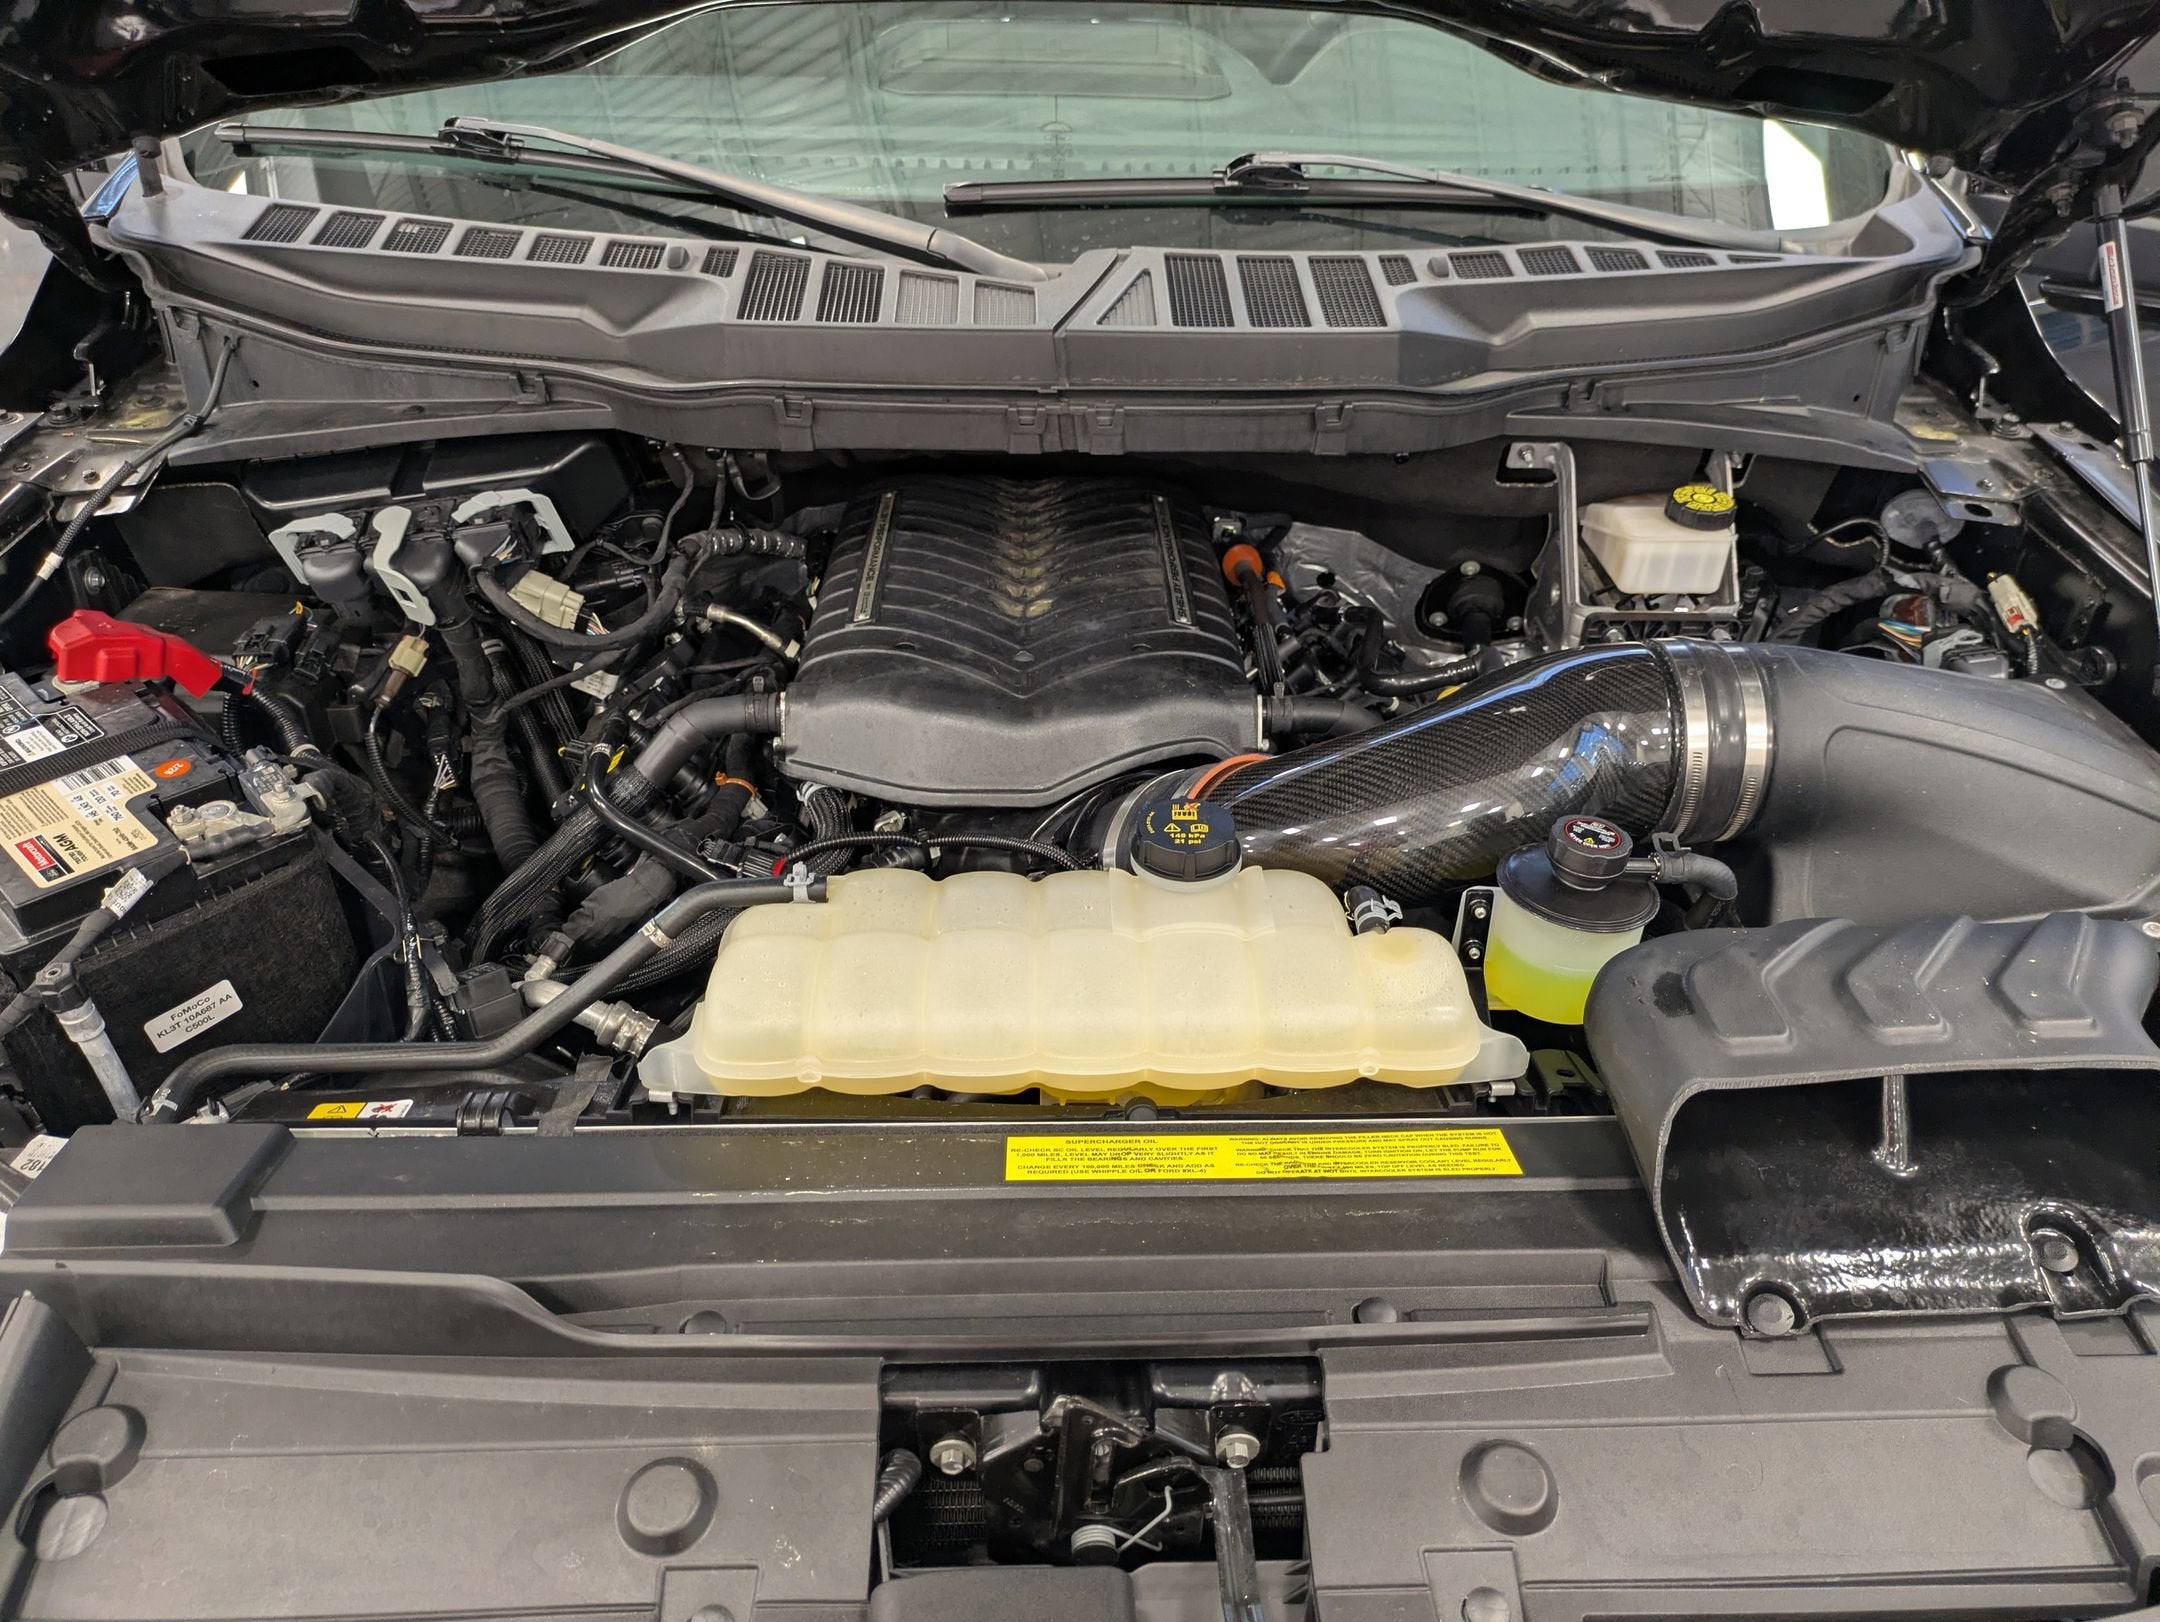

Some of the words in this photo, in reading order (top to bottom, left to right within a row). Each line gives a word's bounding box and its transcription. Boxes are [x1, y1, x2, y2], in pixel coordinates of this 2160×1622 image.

[866, 524, 886, 582] PERFORMANCE
[1162, 523, 1179, 581] PERFORMANCE
[1174, 582, 1187, 618] SHELBY
[21, 841, 50, 867] Motorcraft
[53, 832, 78, 852] AGM
[156, 1023, 182, 1039] KL3T
[184, 1002, 217, 1024] 10A687
[219, 993, 233, 1005] AA
[170, 996, 211, 1021] FoMoCo
[184, 1015, 215, 1033] C500L
